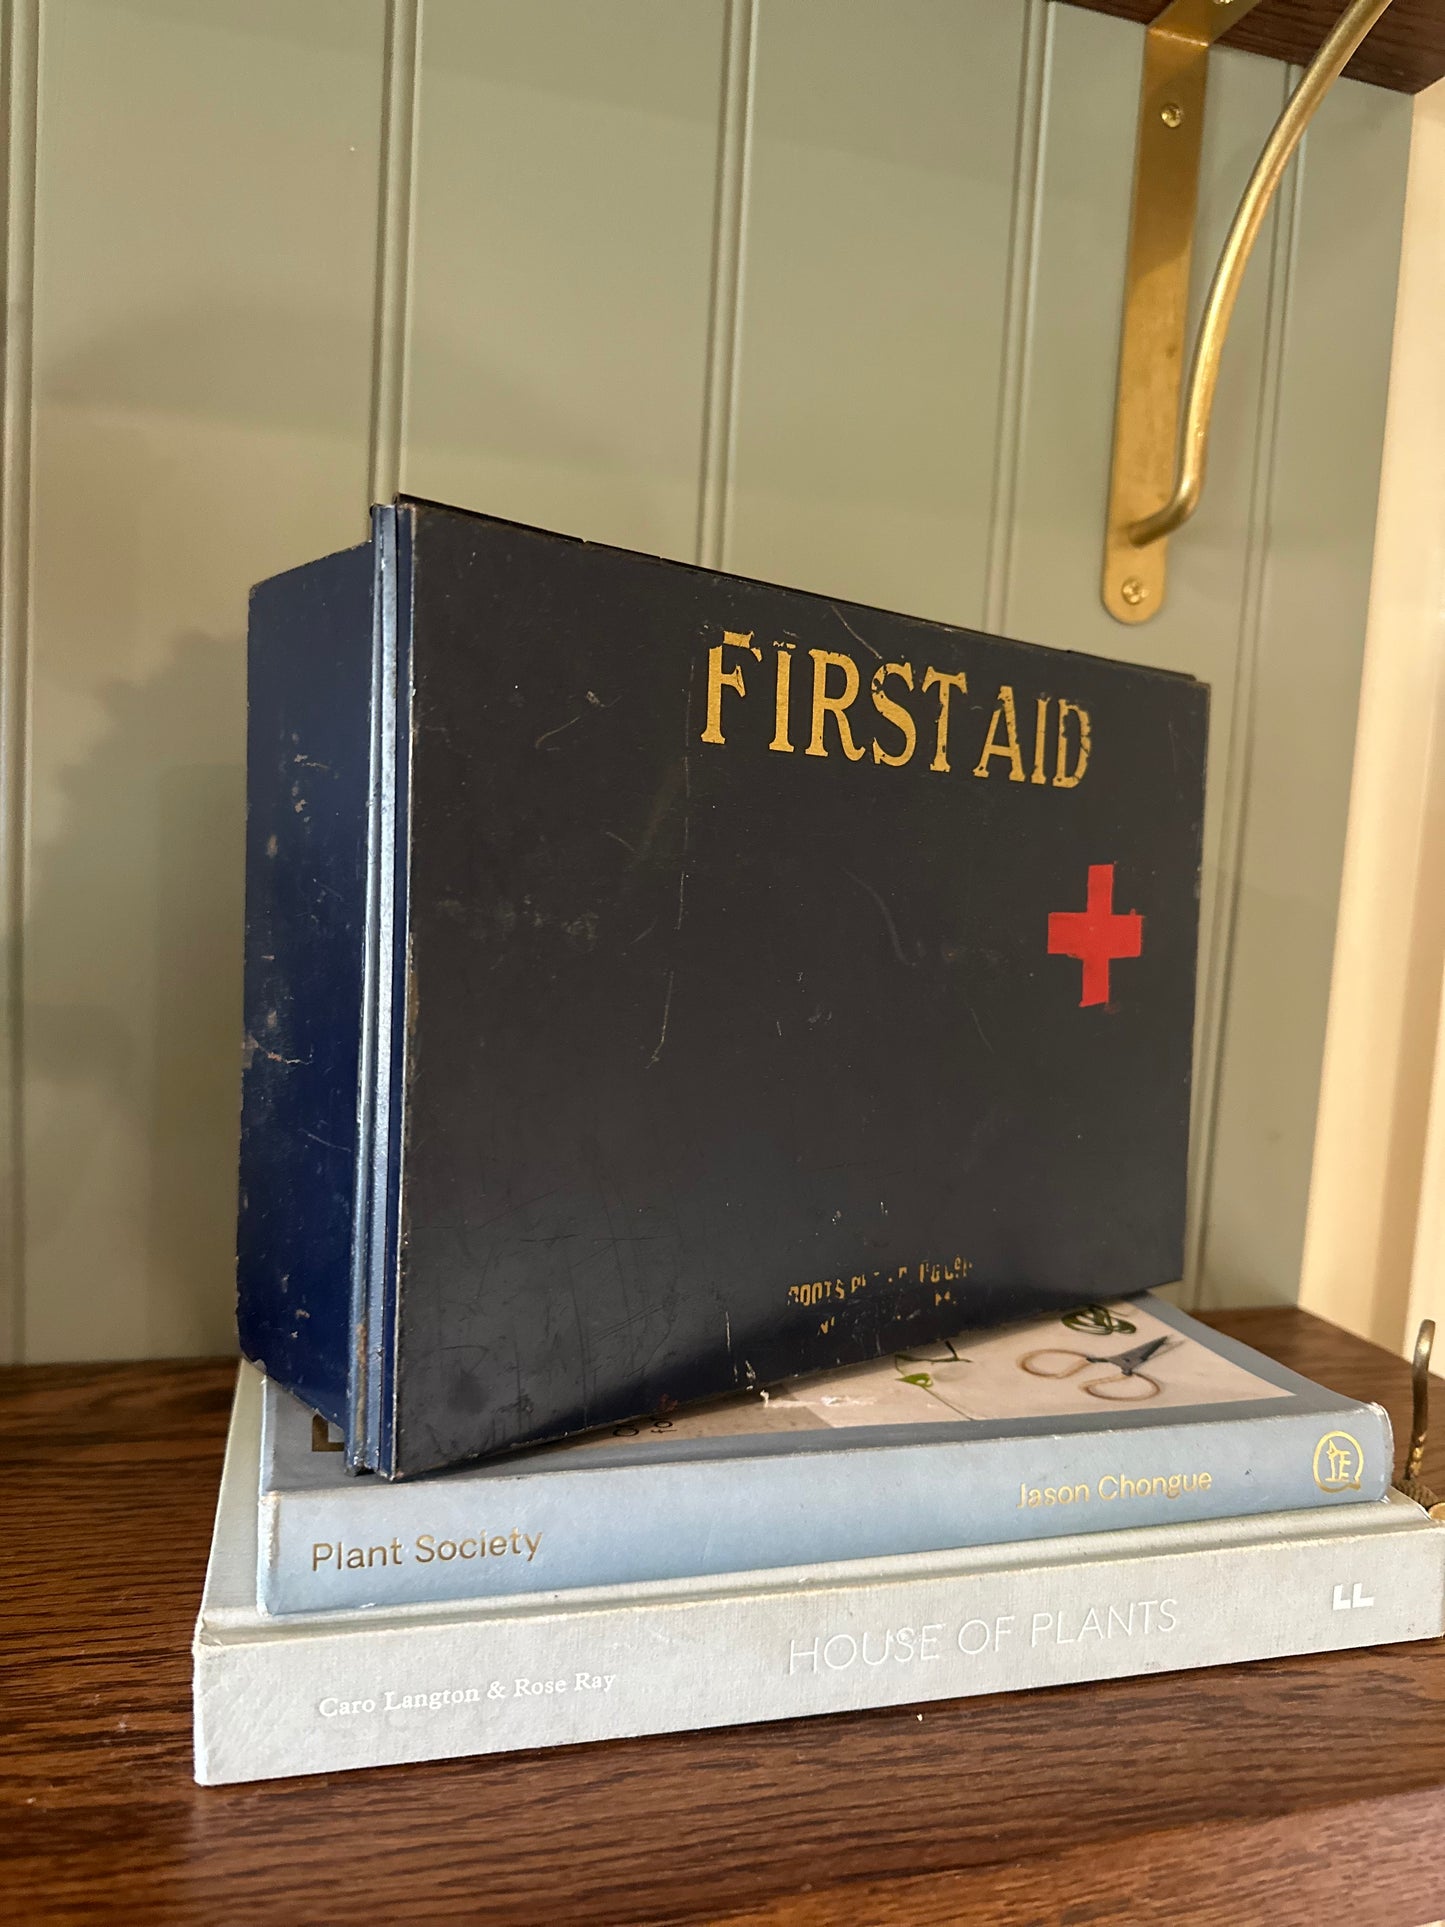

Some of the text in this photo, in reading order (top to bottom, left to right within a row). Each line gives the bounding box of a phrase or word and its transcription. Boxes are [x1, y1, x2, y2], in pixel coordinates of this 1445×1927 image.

[700, 630, 1092, 788] FIRST AID
[1016, 1470, 1212, 1510] Jason Chongue
[311, 1527, 543, 1572] Plant Society
[788, 1598, 1178, 1676] HOUSE OF PLANTS
[319, 1671, 617, 1718] Caro Langton & Rose Ray
